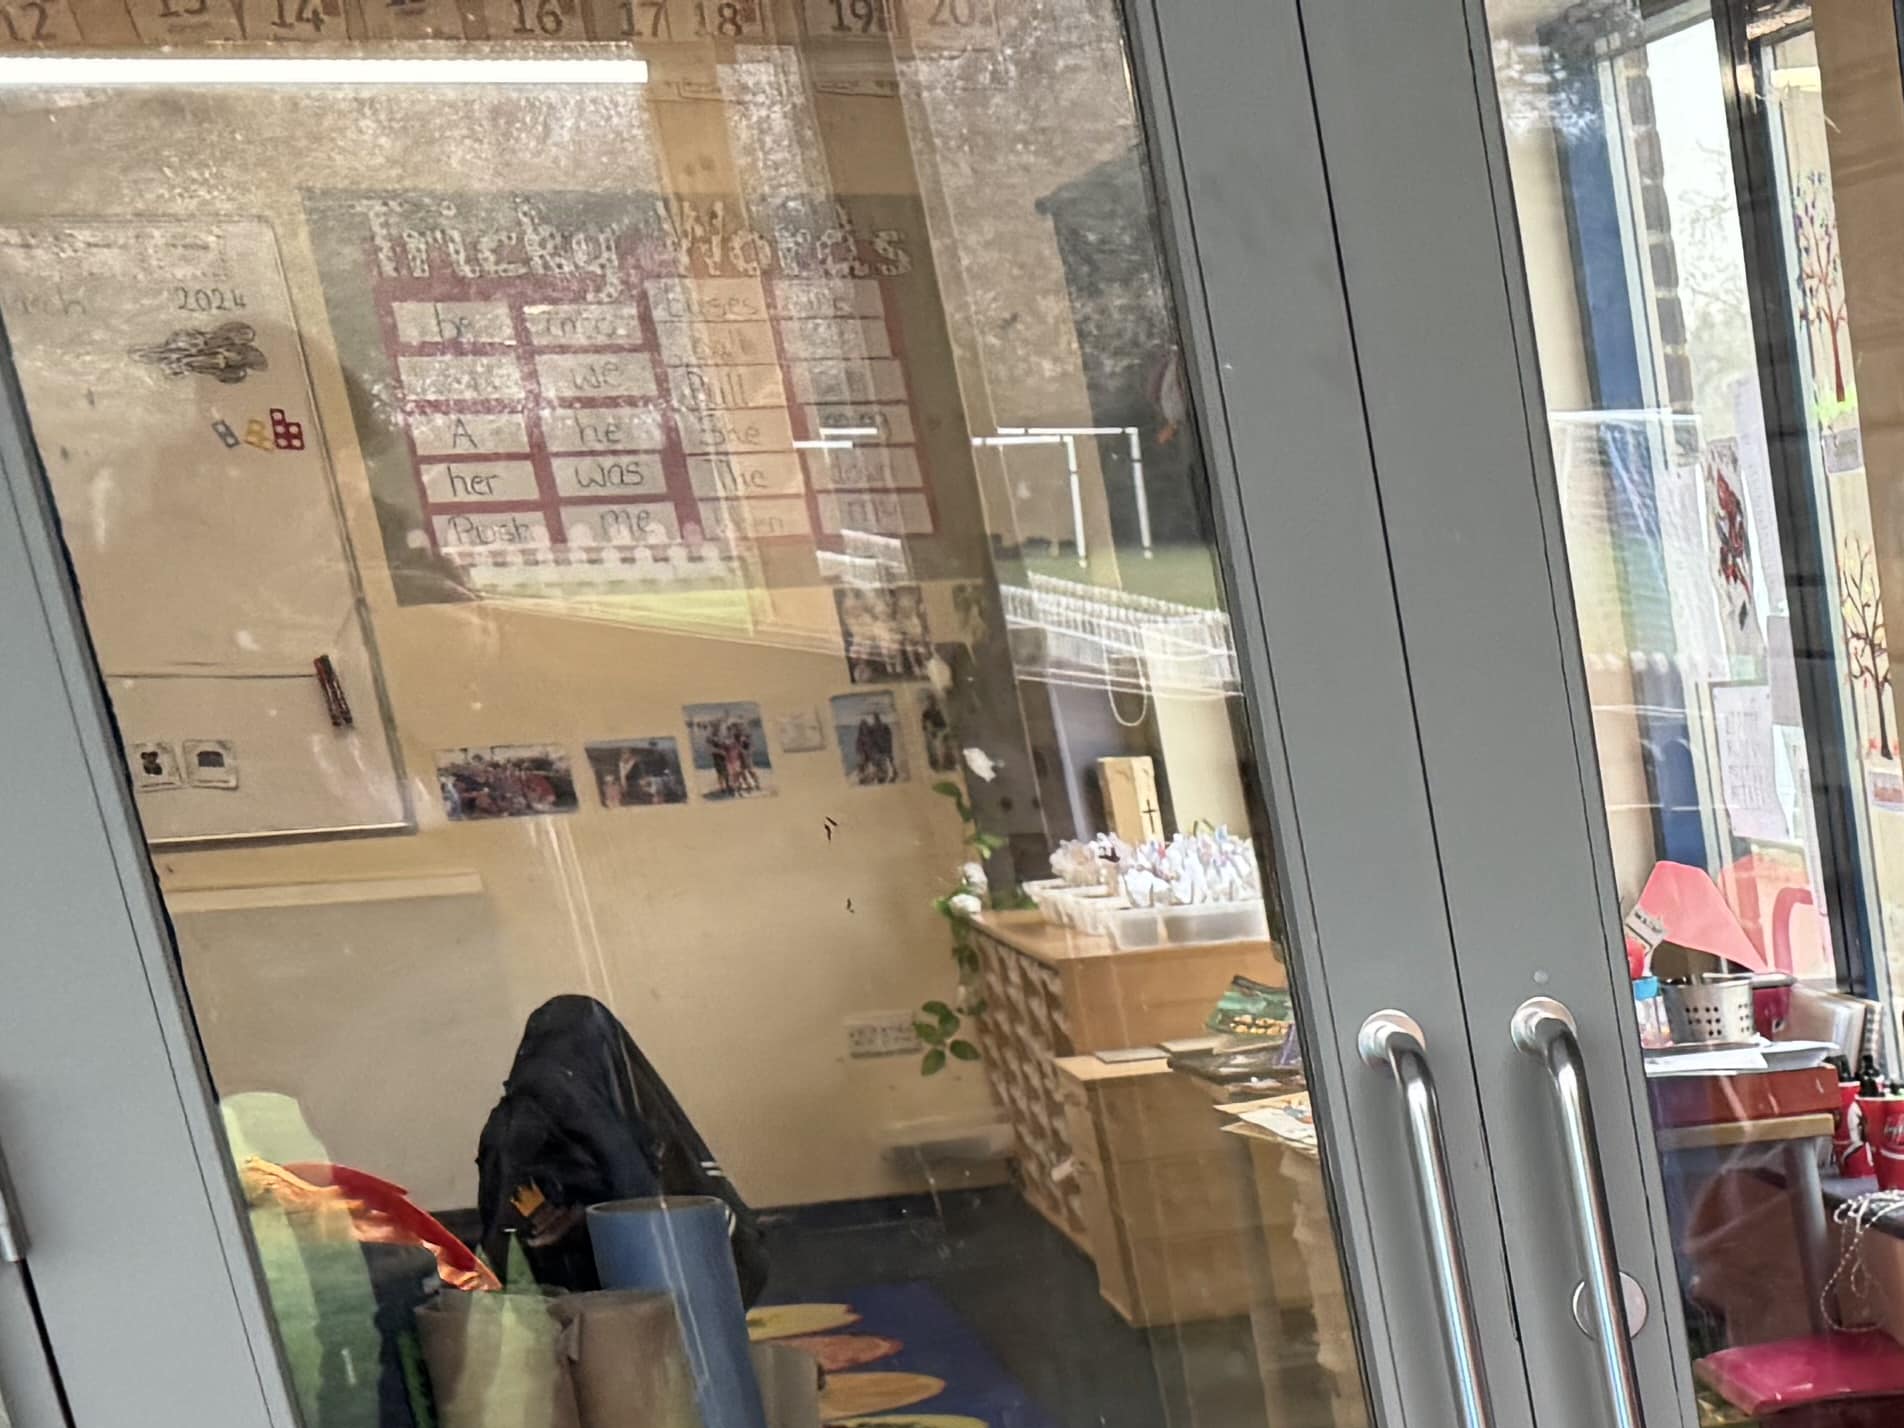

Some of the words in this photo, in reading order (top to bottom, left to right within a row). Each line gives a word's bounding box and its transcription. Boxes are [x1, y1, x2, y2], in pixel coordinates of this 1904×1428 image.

[512, 0, 564, 36] 16
[620, 0, 665, 37] 17
[694, 1, 742, 37] 18
[830, 0, 875, 33] 19
[350, 197, 623, 301] Tricky
[655, 198, 912, 277] Words
[175, 286, 247, 312] 2024
[571, 359, 623, 391] we
[451, 418, 477, 448] A
[575, 411, 621, 444] he
[447, 464, 499, 497] her
[575, 460, 645, 489] was
[448, 515, 528, 545] Push
[600, 509, 657, 539] me
